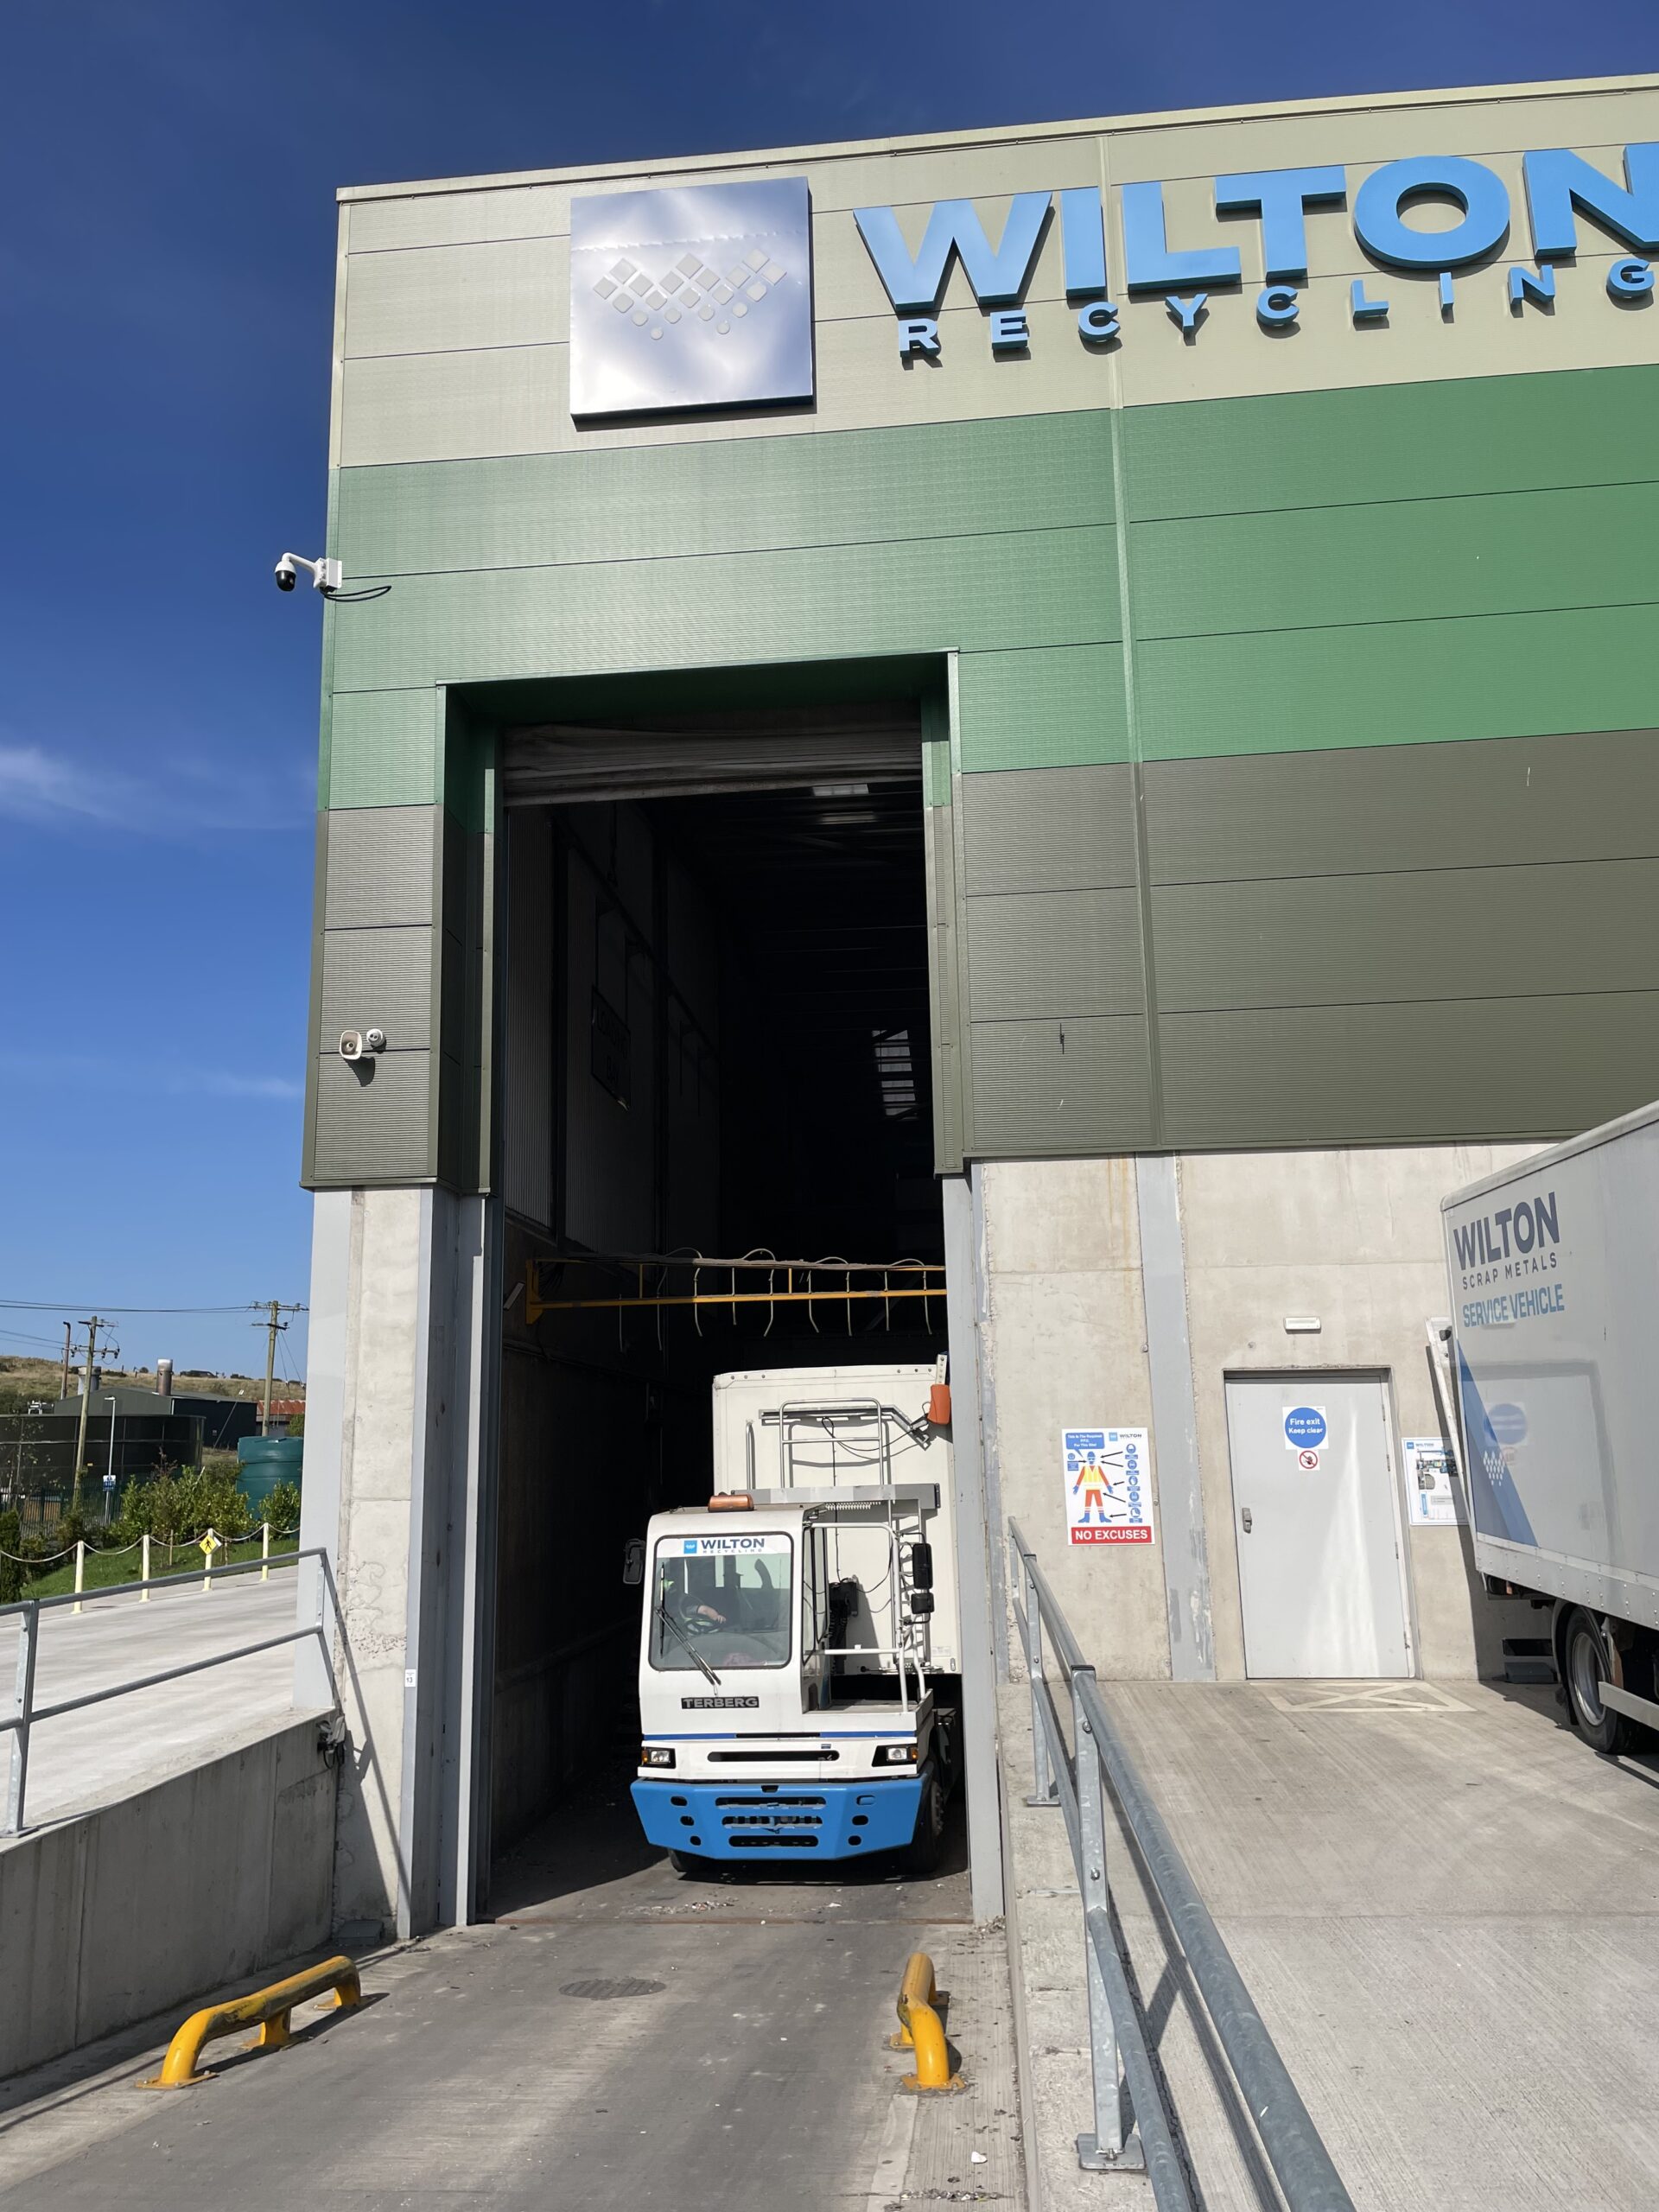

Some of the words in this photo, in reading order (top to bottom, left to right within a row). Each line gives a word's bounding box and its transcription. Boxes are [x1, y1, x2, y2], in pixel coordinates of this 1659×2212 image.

[854, 143, 1659, 313] WILTON
[898, 257, 1656, 359] RECYCLING
[1453, 1192, 1560, 1270] WILTON
[1462, 1268, 1498, 1290] SCRAP
[1505, 1252, 1557, 1279] METALS
[1462, 1296, 1509, 1328] SERVICE
[1510, 1284, 1565, 1319] VEHICLE
[701, 1538, 765, 1549] WILTON
[1075, 1530, 1092, 1540] NO
[1095, 1529, 1148, 1540] EXCUSES
[683, 1697, 758, 1708] TERBERG
